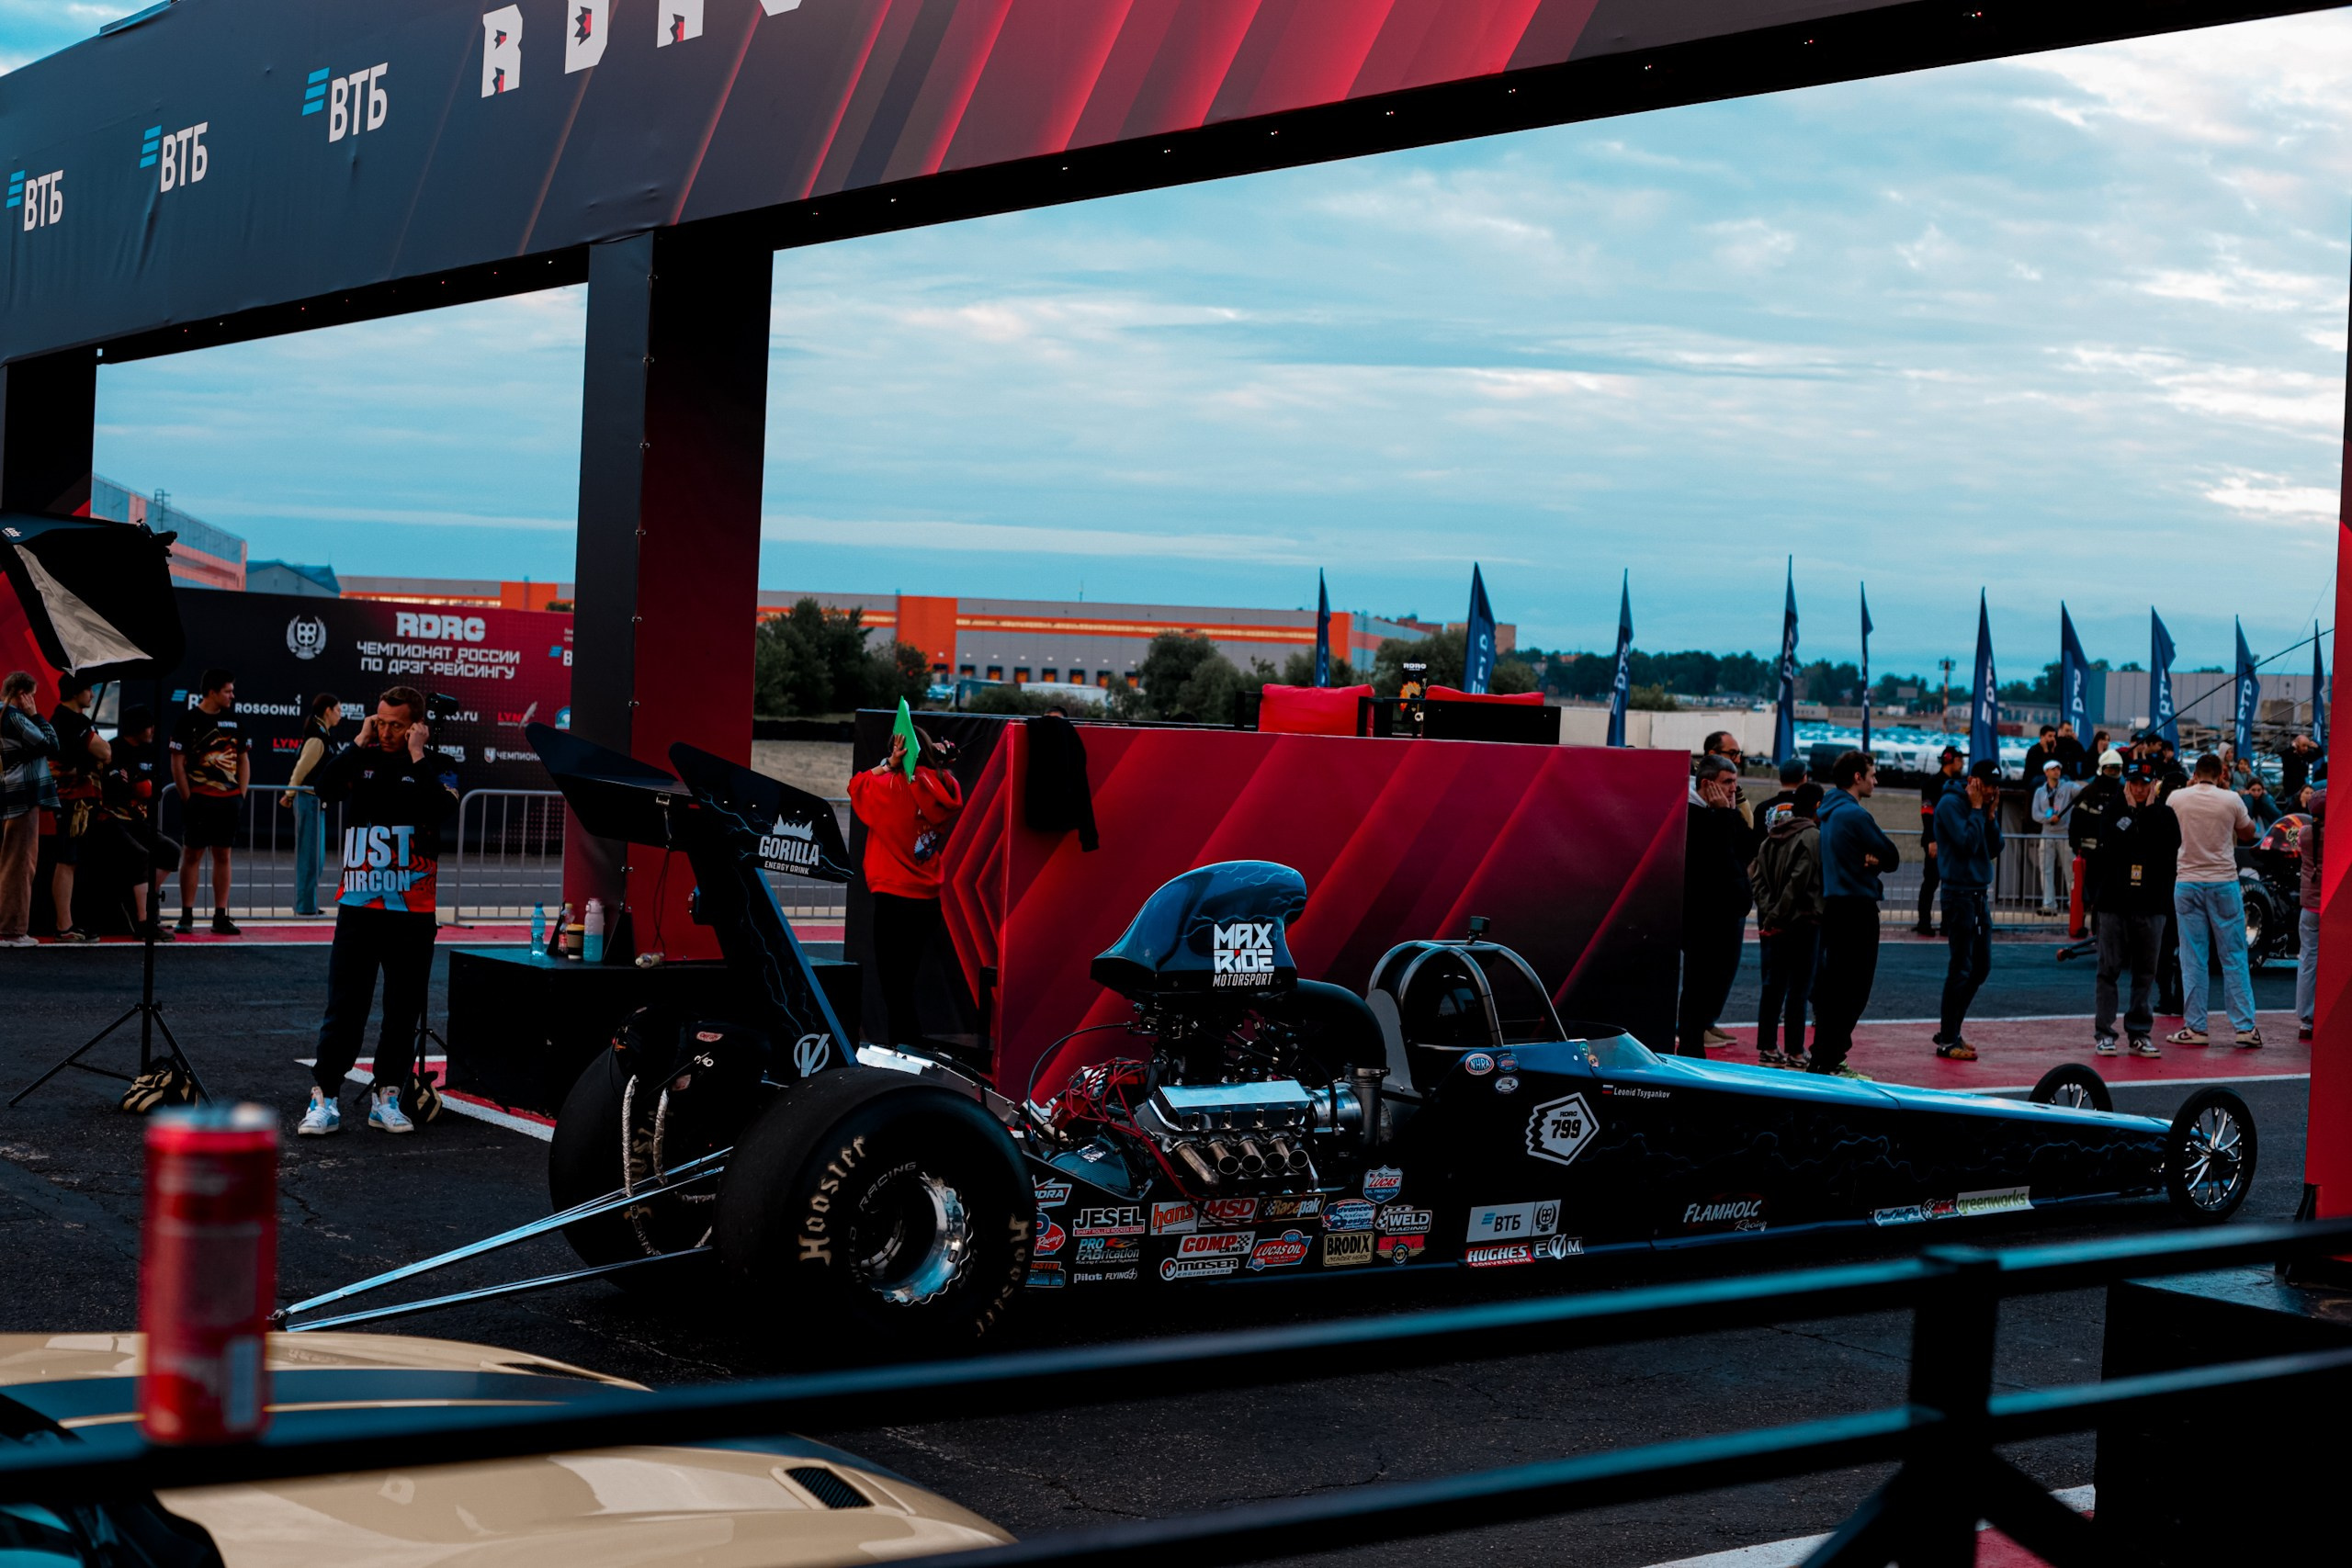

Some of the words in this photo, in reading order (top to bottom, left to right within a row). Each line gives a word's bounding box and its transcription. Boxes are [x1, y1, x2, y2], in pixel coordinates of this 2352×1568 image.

[329, 62, 389, 143] ВТБ
[160, 121, 209, 193] ВТБ
[23, 169, 64, 231] ВТБ
[395, 611, 486, 643] RDRC
[356, 640, 454, 660] ЧЕМПИОНАТ
[457, 648, 521, 665] РОССИИ
[360, 657, 383, 672] ПО
[388, 658, 515, 680] ДРЭГ-РЕЙСИНГУ
[234, 700, 301, 716] ROSGONKI
[758, 835, 820, 867] GORILLA
[764, 860, 790, 873] ENERGY
[789, 864, 810, 876] DRINK
[1214, 923, 1273, 950] MAX
[1214, 949, 1275, 975] RIDE
[1212, 973, 1273, 987] MOTORSPORT
[1470, 1057, 1491, 1070] NHRA
[1613, 1087, 1636, 1097] Leonid
[1636, 1088, 1671, 1100] Tsygankov
[1552, 1119, 1582, 1139] 799
[1368, 1178, 1400, 1188] LUCAS
[1205, 1199, 1256, 1218] MSD
[1272, 1197, 1321, 1218] Racepak
[1957, 1190, 2026, 1215] greenworks
[1073, 1206, 1146, 1229] JESEL
[1152, 1204, 1194, 1234] hans
[1388, 1213, 1430, 1226] WELD
[1494, 1213, 1521, 1233] ВТБ
[1734, 1219, 1768, 1232] Racing
[1079, 1237, 1105, 1249] PRO
[1182, 1235, 1238, 1253] COMP
[1256, 1244, 1288, 1257] LUCAS
[1287, 1244, 1302, 1254] OIL
[1327, 1235, 1370, 1256] BRODIX
[1076, 1247, 1139, 1260] FABrication
[1467, 1245, 1529, 1263] HUGHES
[1471, 1258, 1532, 1268] CONVERTERS
[1177, 1259, 1237, 1270] MOSER
[1073, 1273, 1103, 1284] Pilot
[1104, 1271, 1129, 1280] FLYING
